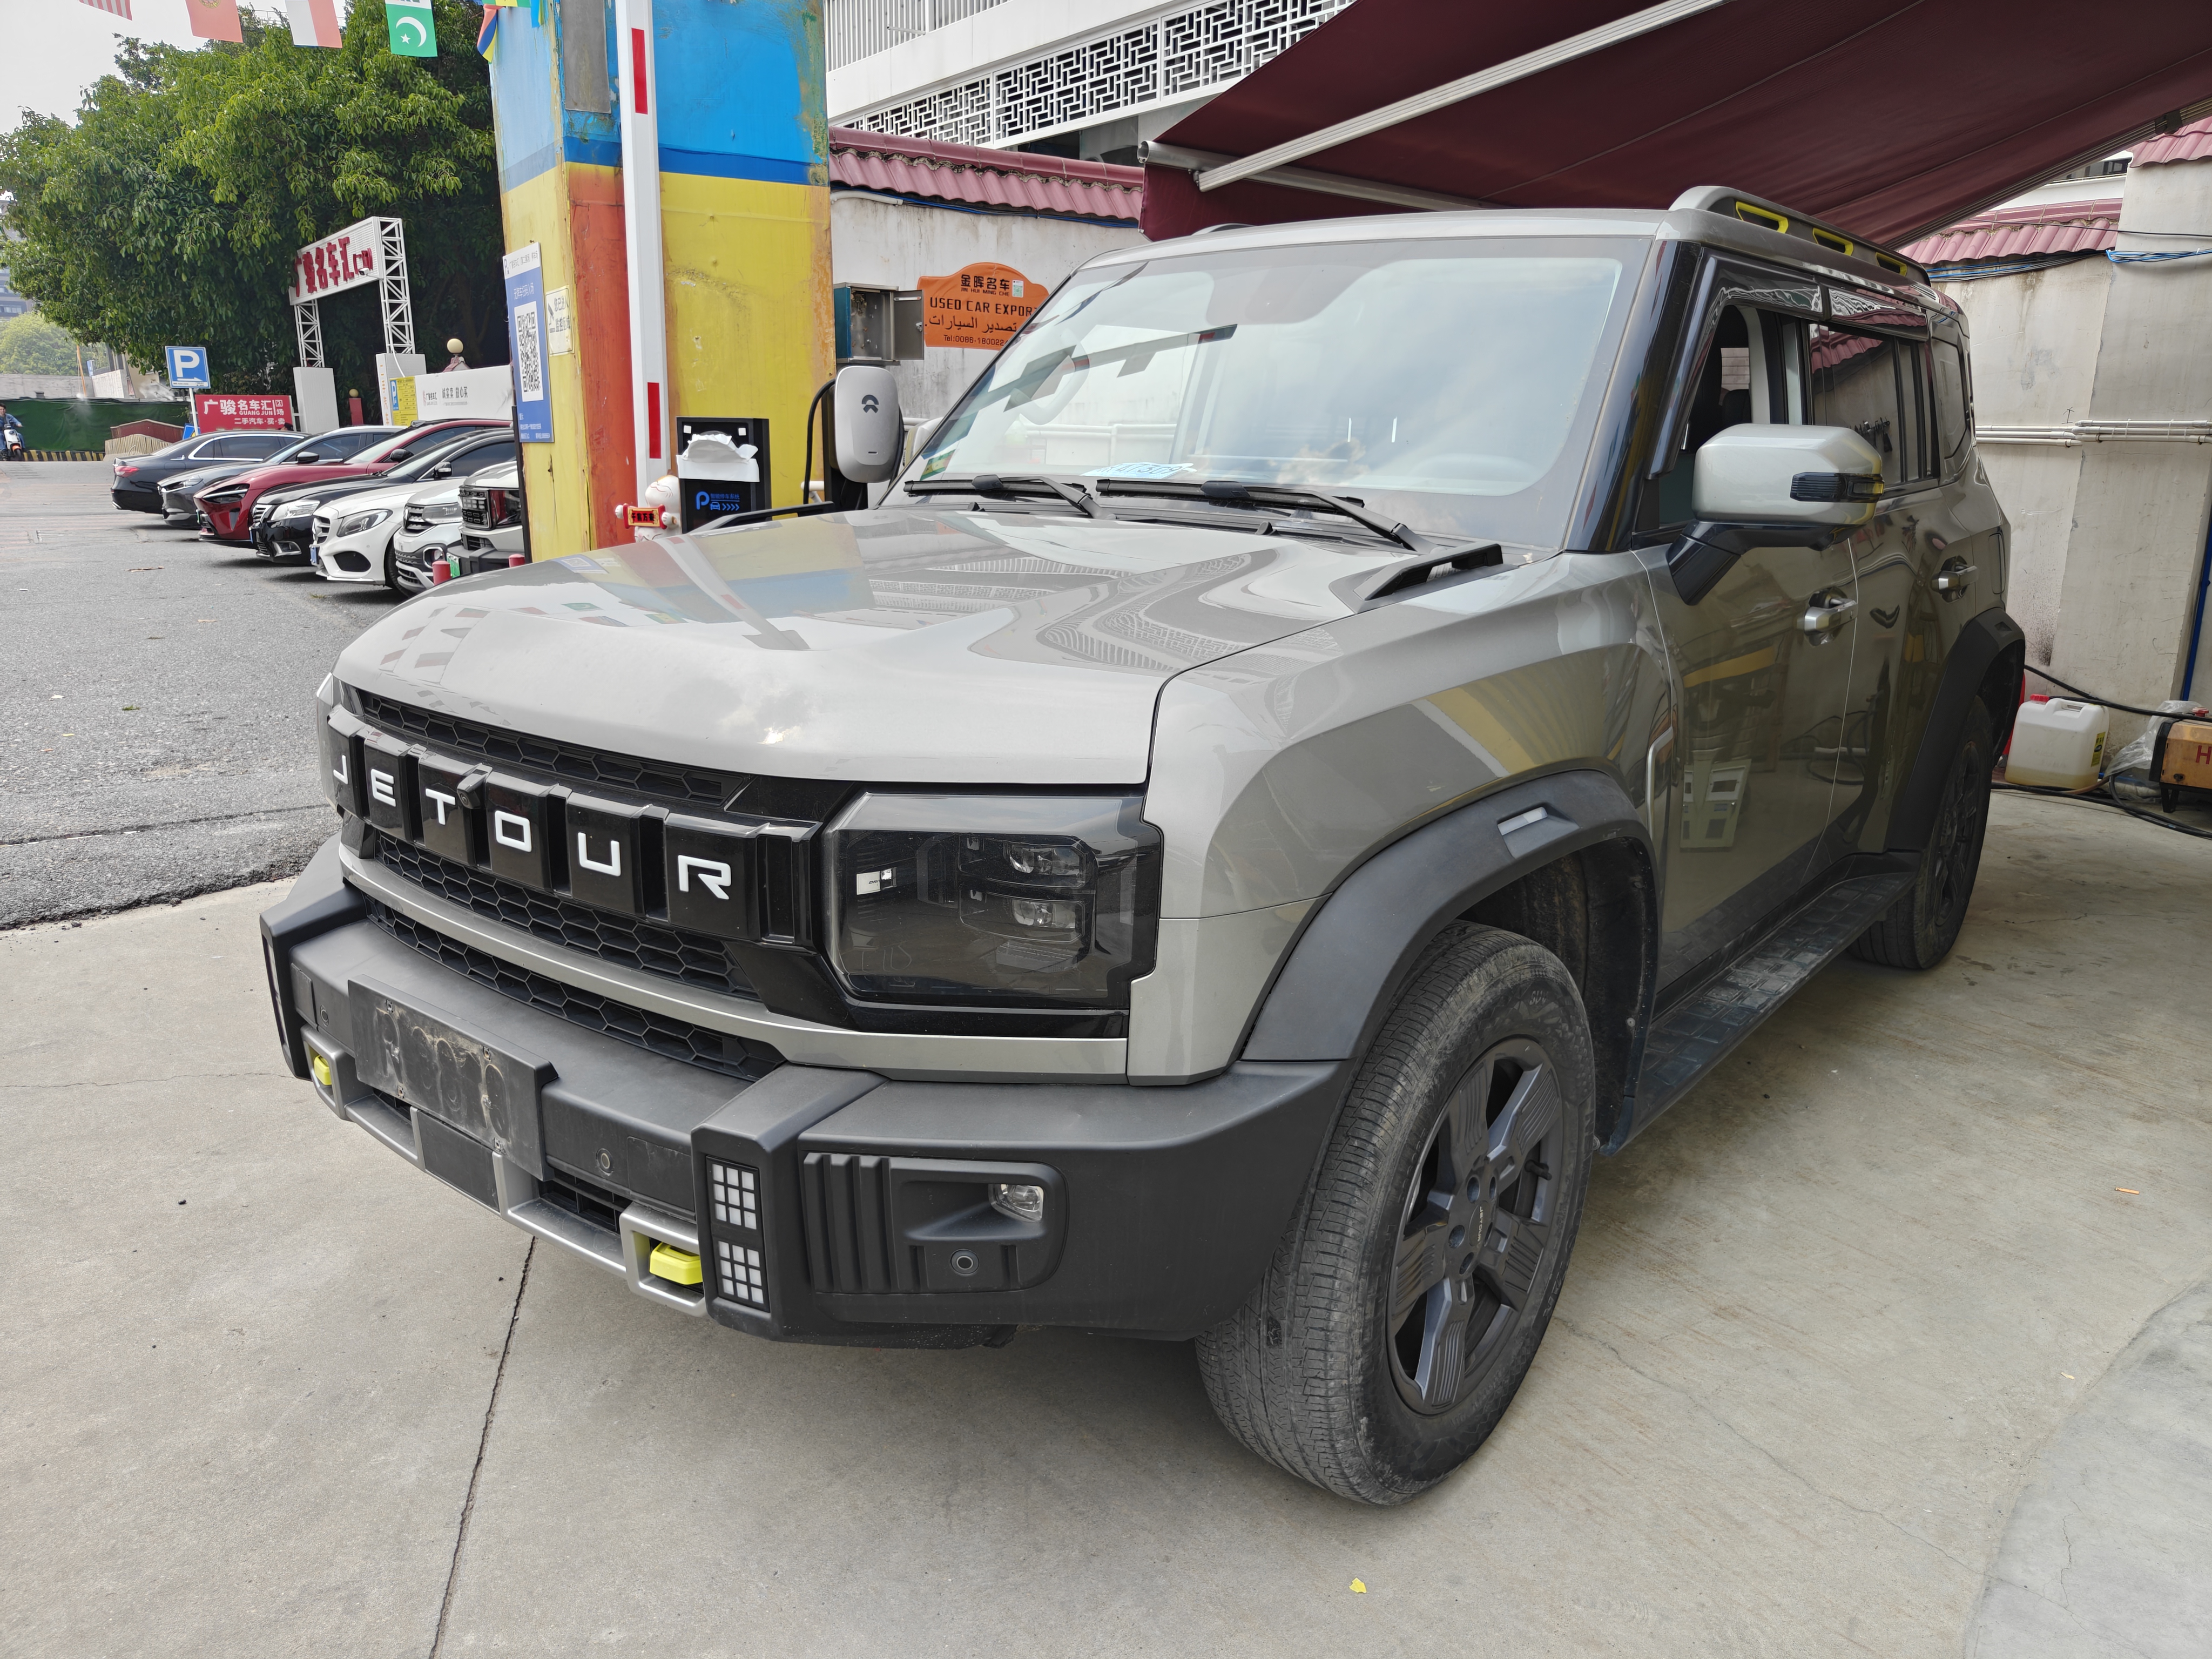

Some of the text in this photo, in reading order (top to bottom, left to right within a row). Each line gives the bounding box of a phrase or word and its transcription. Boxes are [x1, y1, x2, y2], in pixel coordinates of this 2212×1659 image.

[961, 274, 1010, 291] 金晖名车
[930, 297, 961, 311] USED
[967, 301, 990, 313] CAR
[943, 334, 1008, 346] Tel:0086-180022
[173, 350, 200, 377] P
[204, 399, 273, 415] 广骏名车汇
[333, 754, 732, 901] JETOUR
